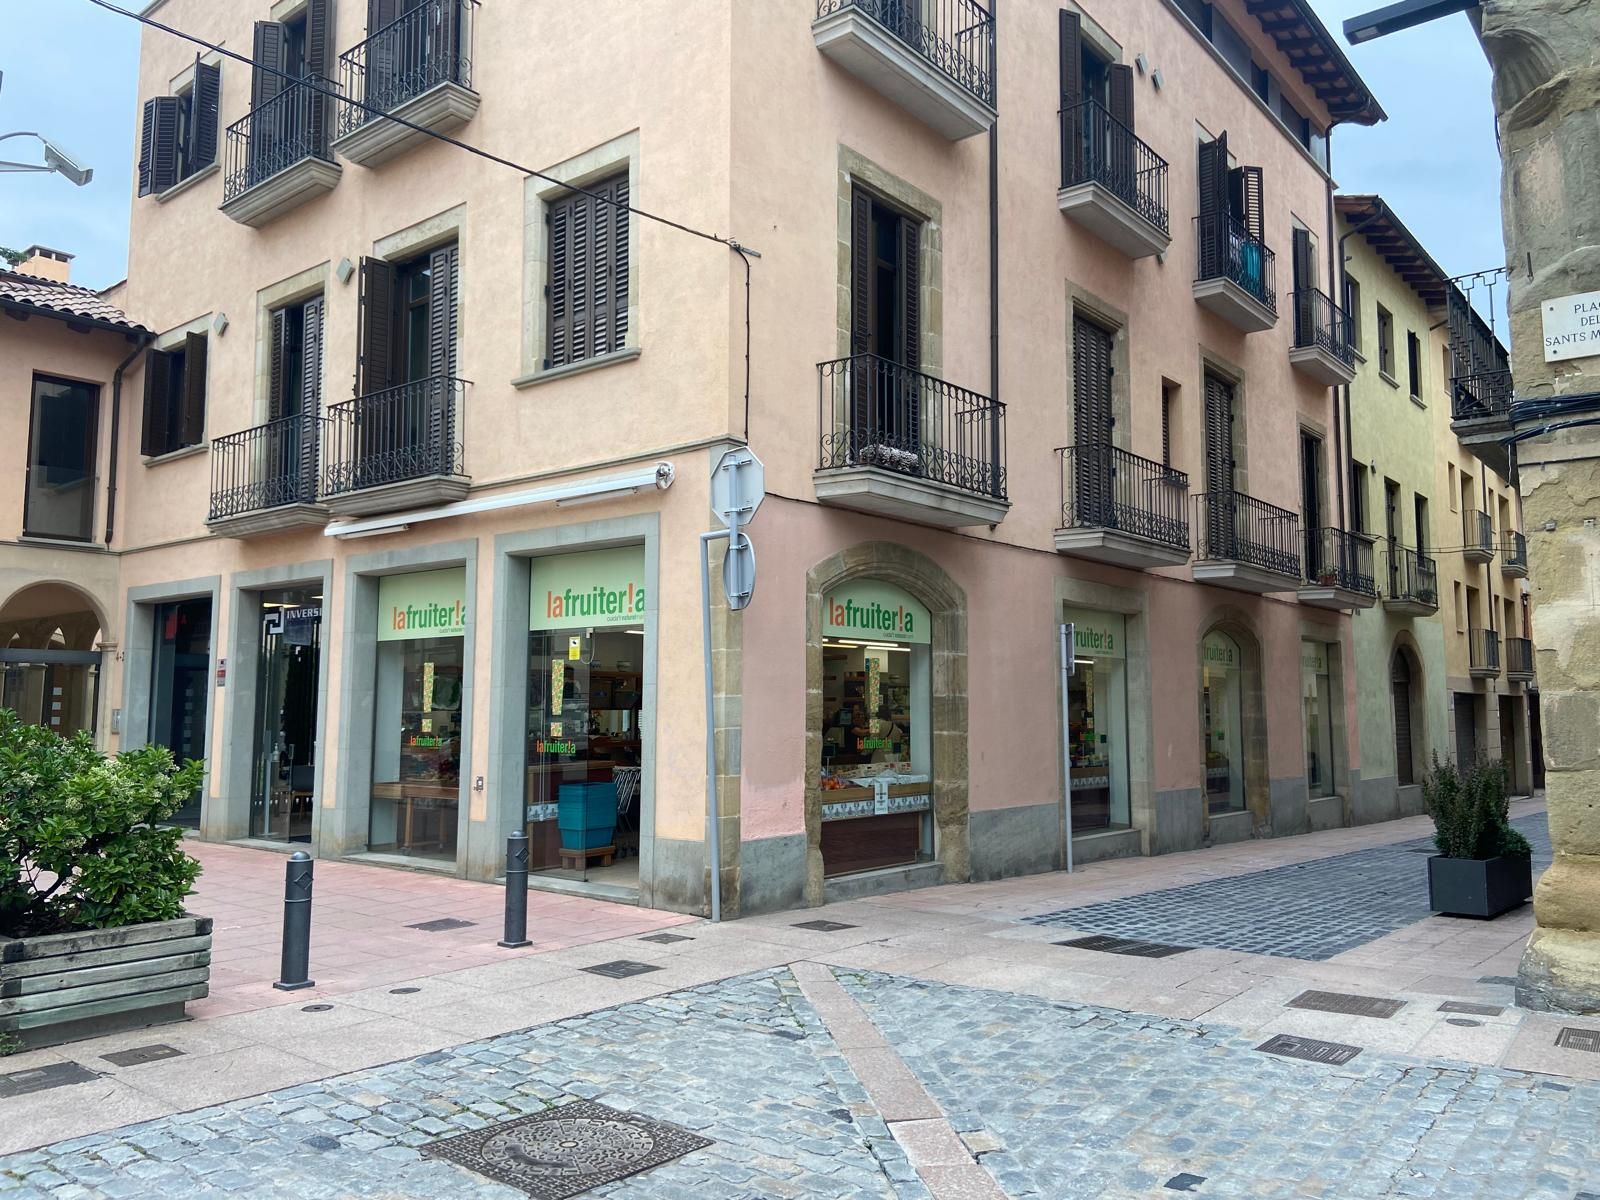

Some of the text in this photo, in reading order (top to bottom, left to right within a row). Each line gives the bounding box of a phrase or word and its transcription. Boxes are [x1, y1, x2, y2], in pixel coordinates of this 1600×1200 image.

[1574, 302, 1600, 314] PLA
[1545, 332, 1586, 347] SANTS
[1074, 627, 1113, 650] ruiter!a
